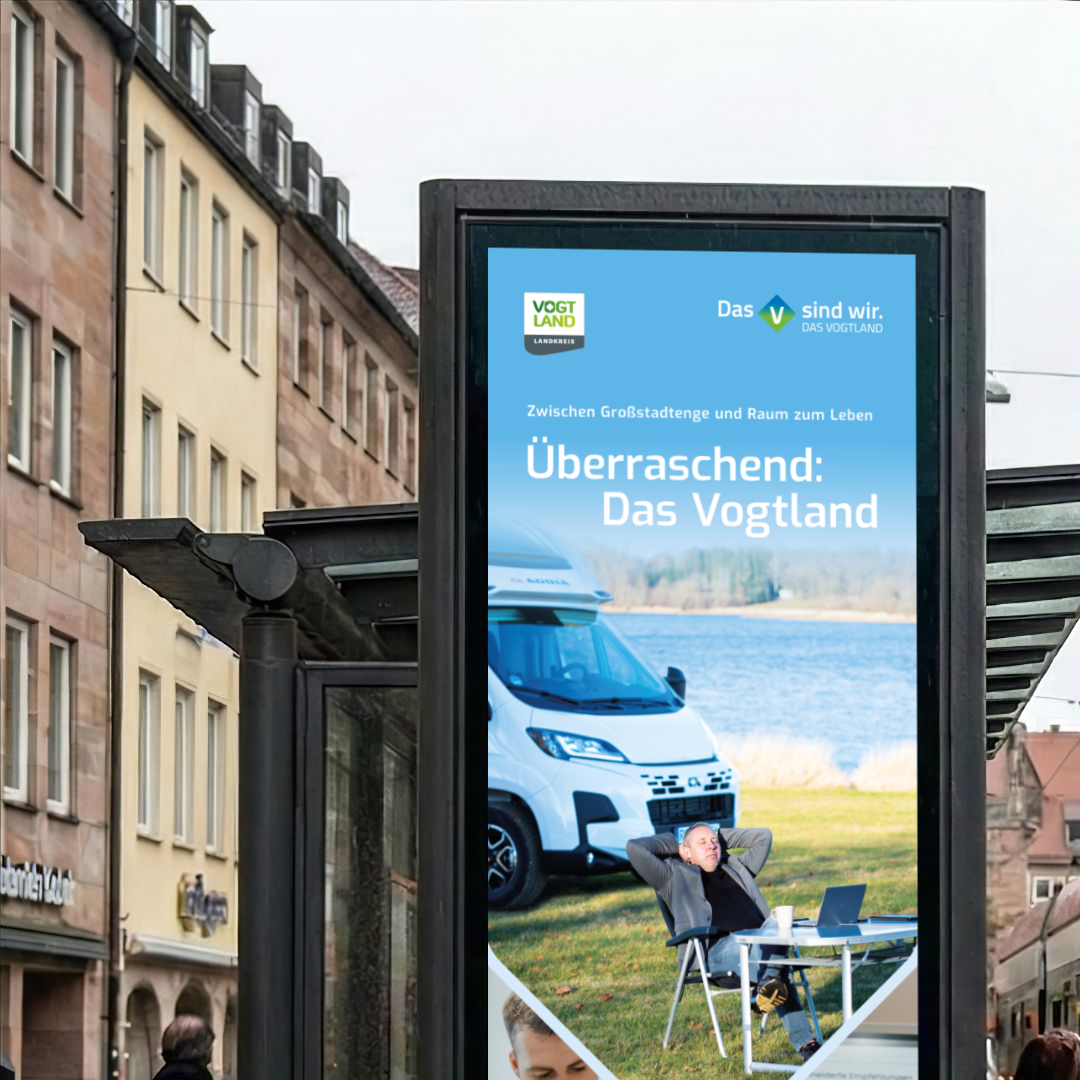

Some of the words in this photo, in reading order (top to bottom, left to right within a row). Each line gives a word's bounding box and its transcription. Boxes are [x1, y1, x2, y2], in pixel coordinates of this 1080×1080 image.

[532, 300, 577, 314] VOGT
[718, 300, 754, 318] Das
[769, 306, 784, 325] V
[802, 301, 843, 319] sind
[848, 301, 883, 320] wir.
[533, 314, 576, 328] LAND
[802, 322, 824, 333] DAS
[825, 322, 884, 334] VOGTLAND
[527, 404, 596, 418] Zwischen
[600, 405, 710, 423] Großstadtenge
[715, 407, 742, 420] und
[747, 407, 789, 420] Raum
[793, 411, 825, 421] zum
[830, 408, 873, 422] Leben
[527, 436, 822, 482] Überraschend:
[603, 491, 677, 527] Das
[692, 492, 878, 539] Vogtland
